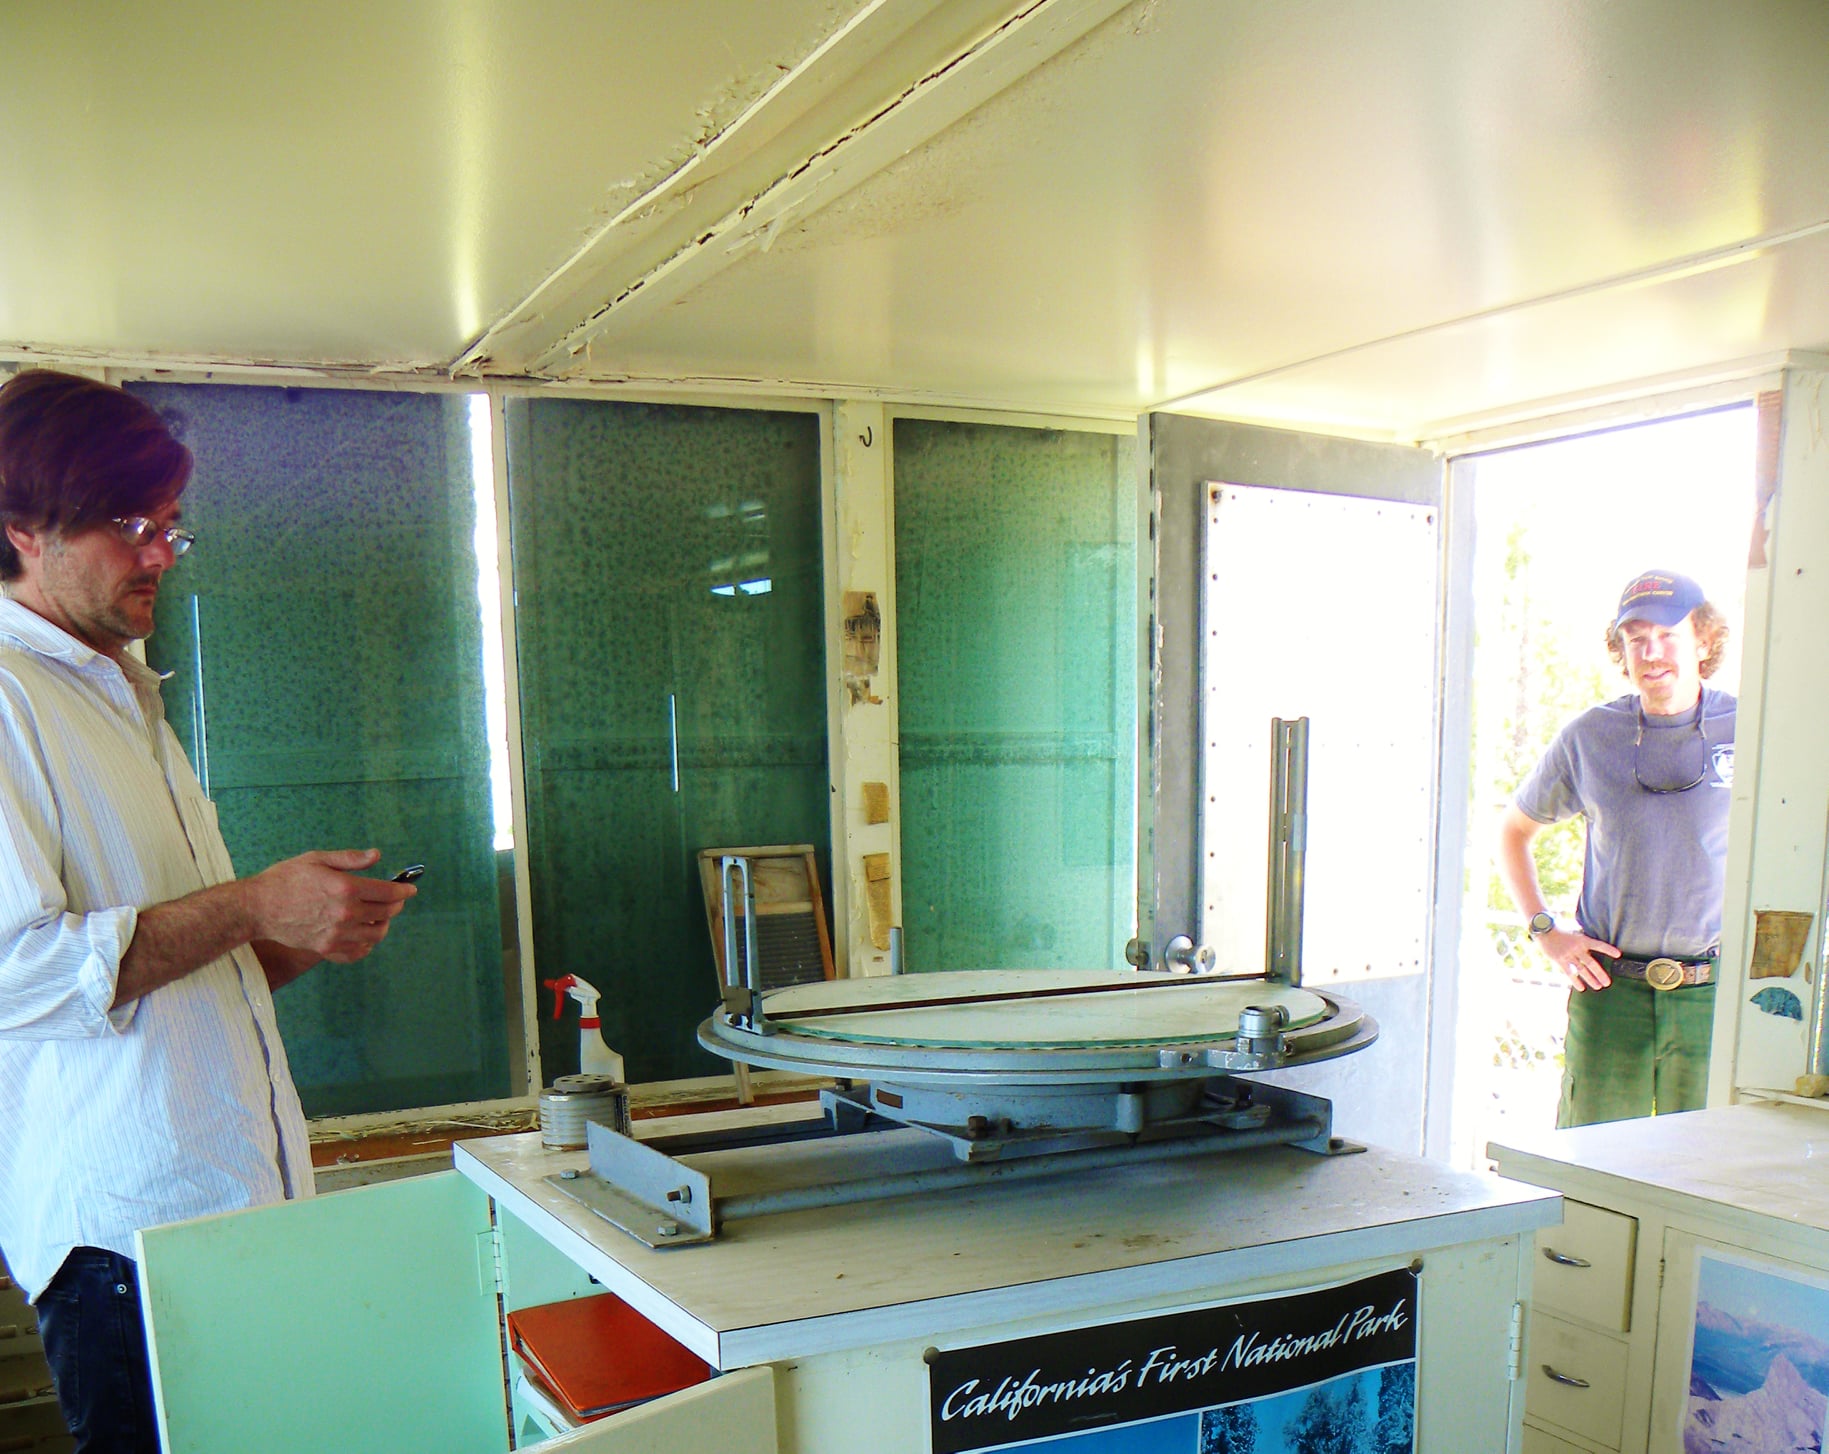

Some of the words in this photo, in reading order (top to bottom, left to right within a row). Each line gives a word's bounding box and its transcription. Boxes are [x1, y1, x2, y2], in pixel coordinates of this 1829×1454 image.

[941, 1358, 1132, 1422] California's
[1137, 1346, 1218, 1388] First
[1220, 1314, 1345, 1373] National
[1342, 1298, 1409, 1345] Park
